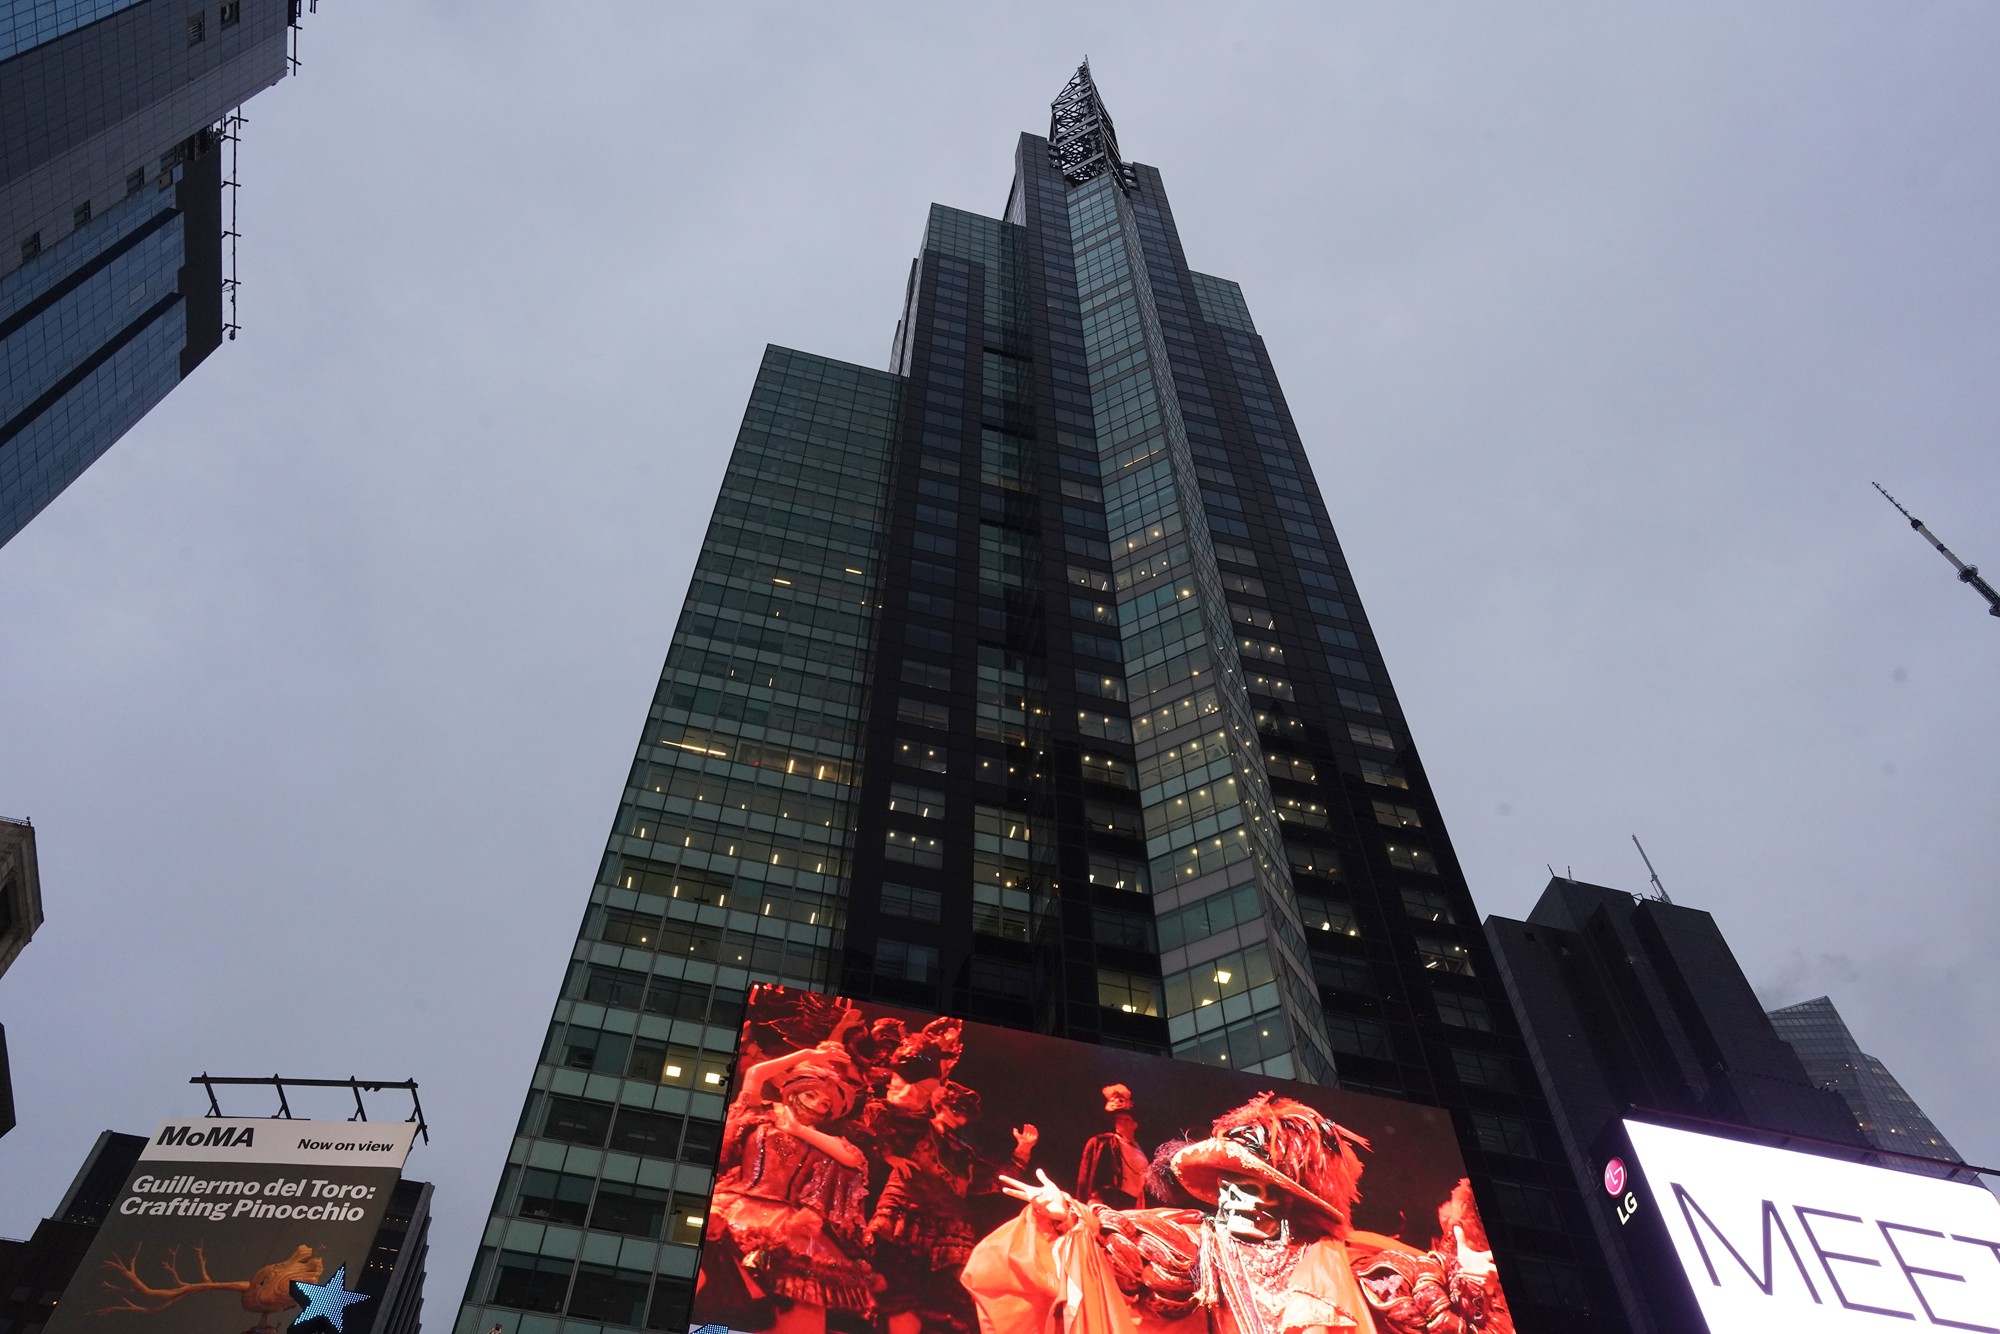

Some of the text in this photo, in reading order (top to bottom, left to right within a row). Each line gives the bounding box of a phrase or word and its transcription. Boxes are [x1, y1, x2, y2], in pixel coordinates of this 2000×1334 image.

[156, 1126, 255, 1148] MoMA
[297, 1138, 395, 1153] Now on view
[132, 1175, 377, 1200] Guillermo del Toro:
[119, 1196, 365, 1222] Crafting Pinocchio
[1616, 1191, 1638, 1226] LG
